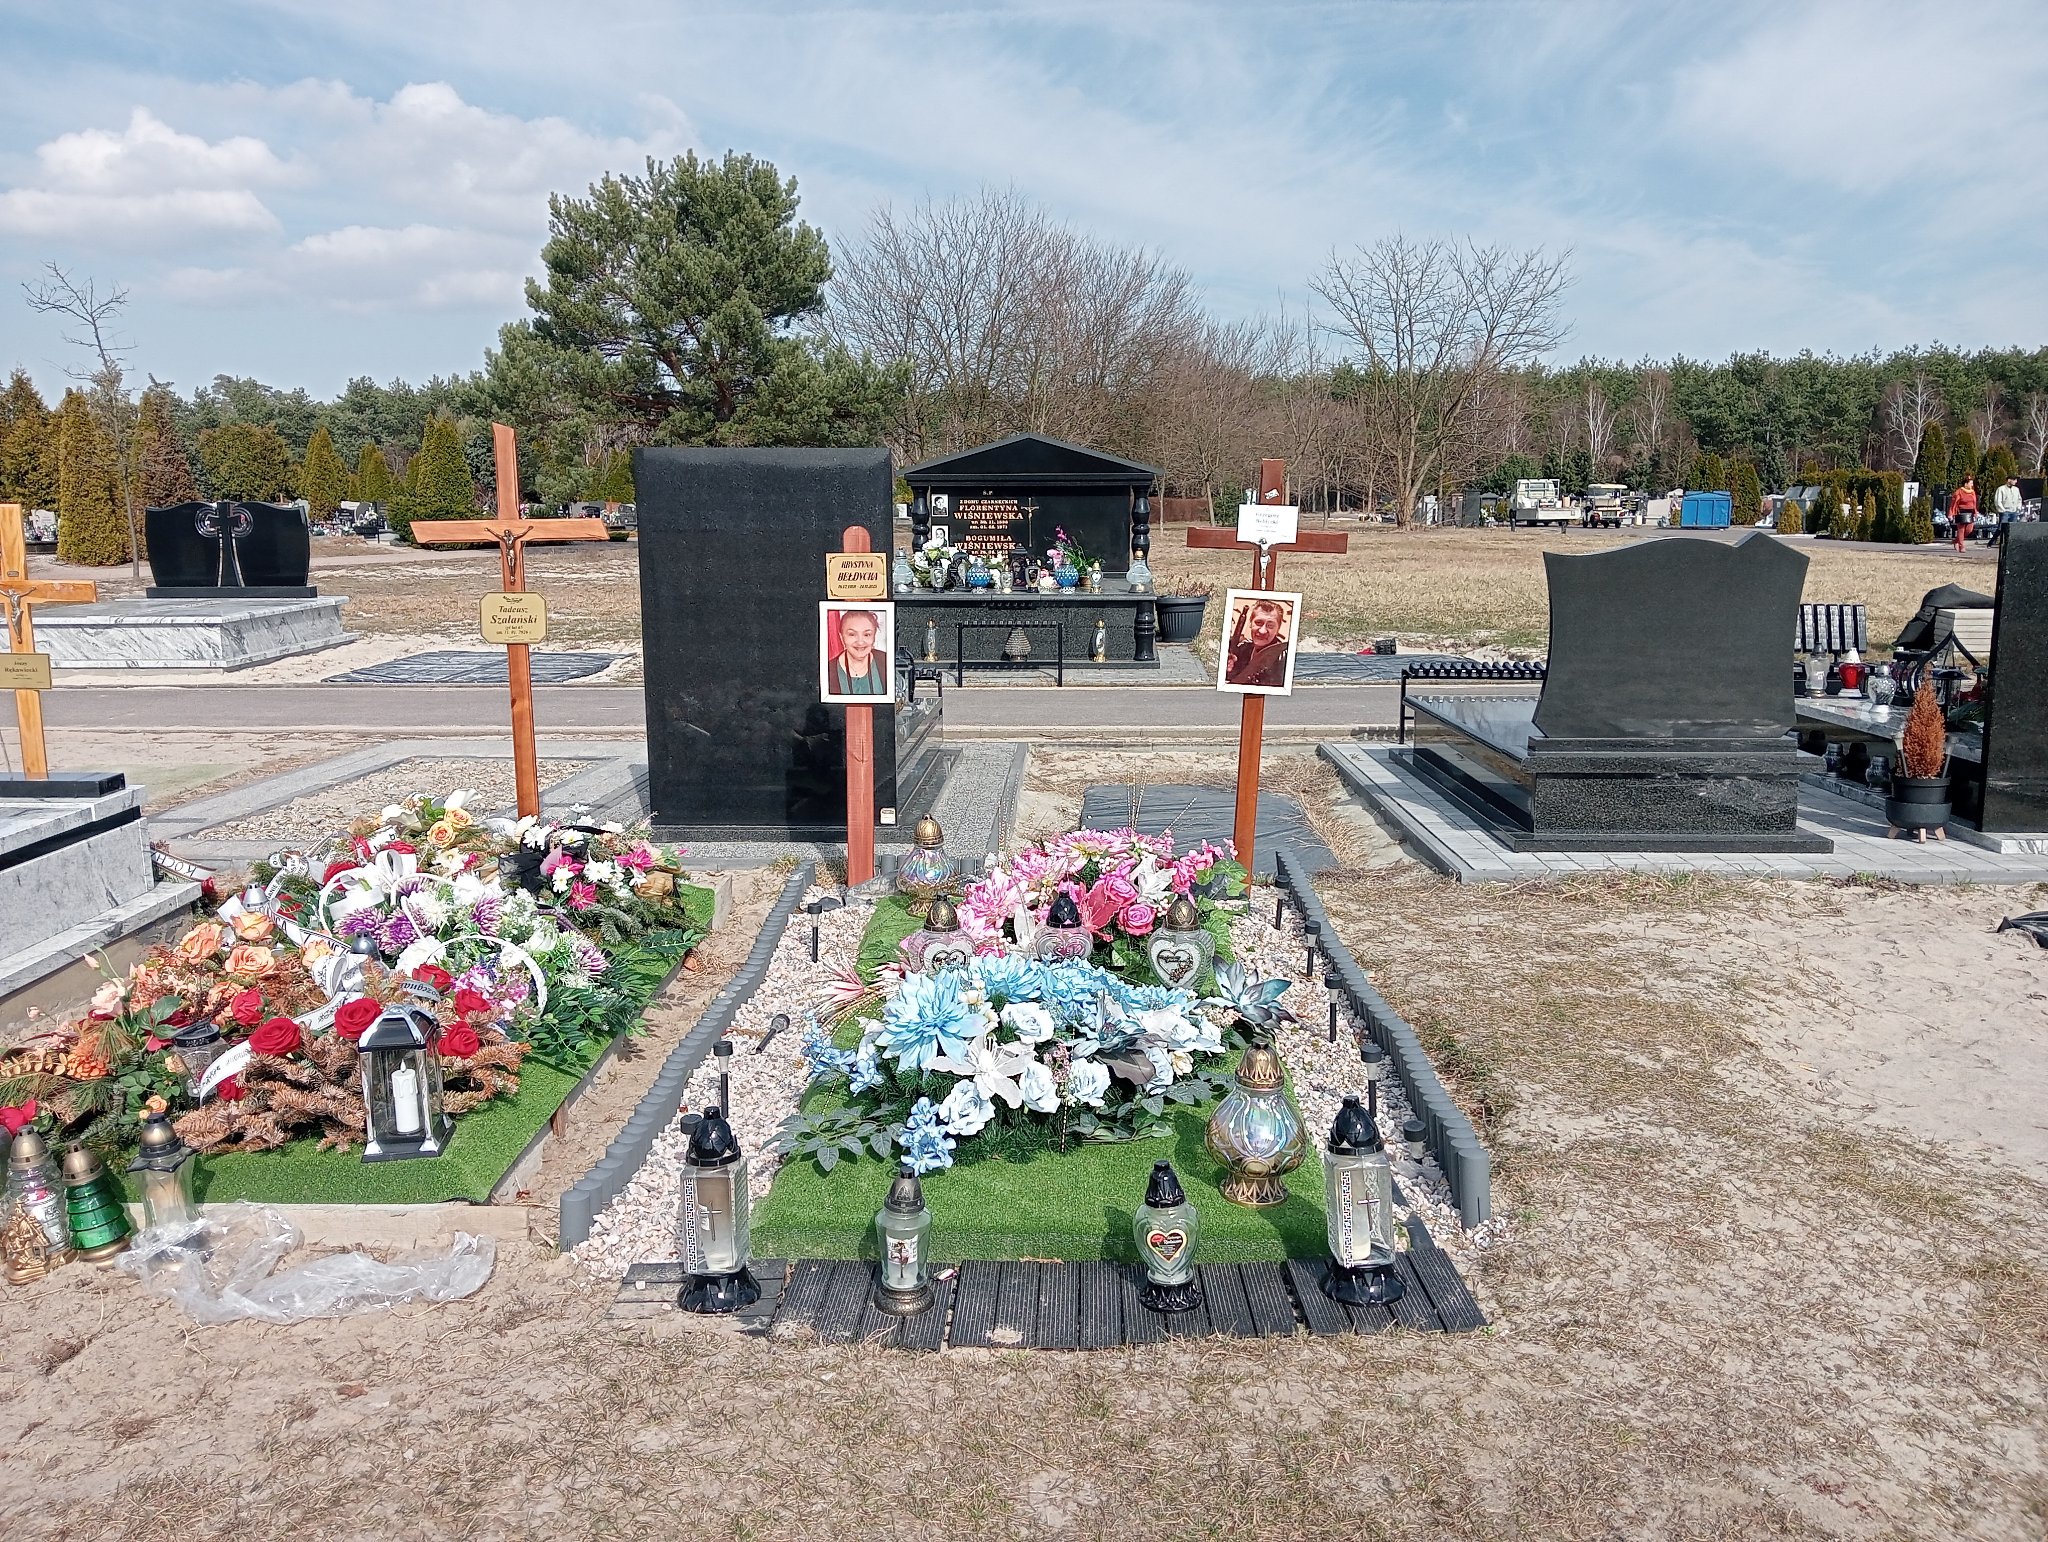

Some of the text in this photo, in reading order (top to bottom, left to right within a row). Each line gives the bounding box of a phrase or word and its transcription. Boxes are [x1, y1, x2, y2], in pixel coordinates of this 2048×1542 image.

[954, 511, 1024, 520] WIŚNIEWSKA
[954, 541, 1016, 550] WIŚNIEWSK
[841, 560, 874, 569] KRYSTYNA
[499, 605, 529, 613] Tadeusz
[490, 614, 538, 624] Szałański
